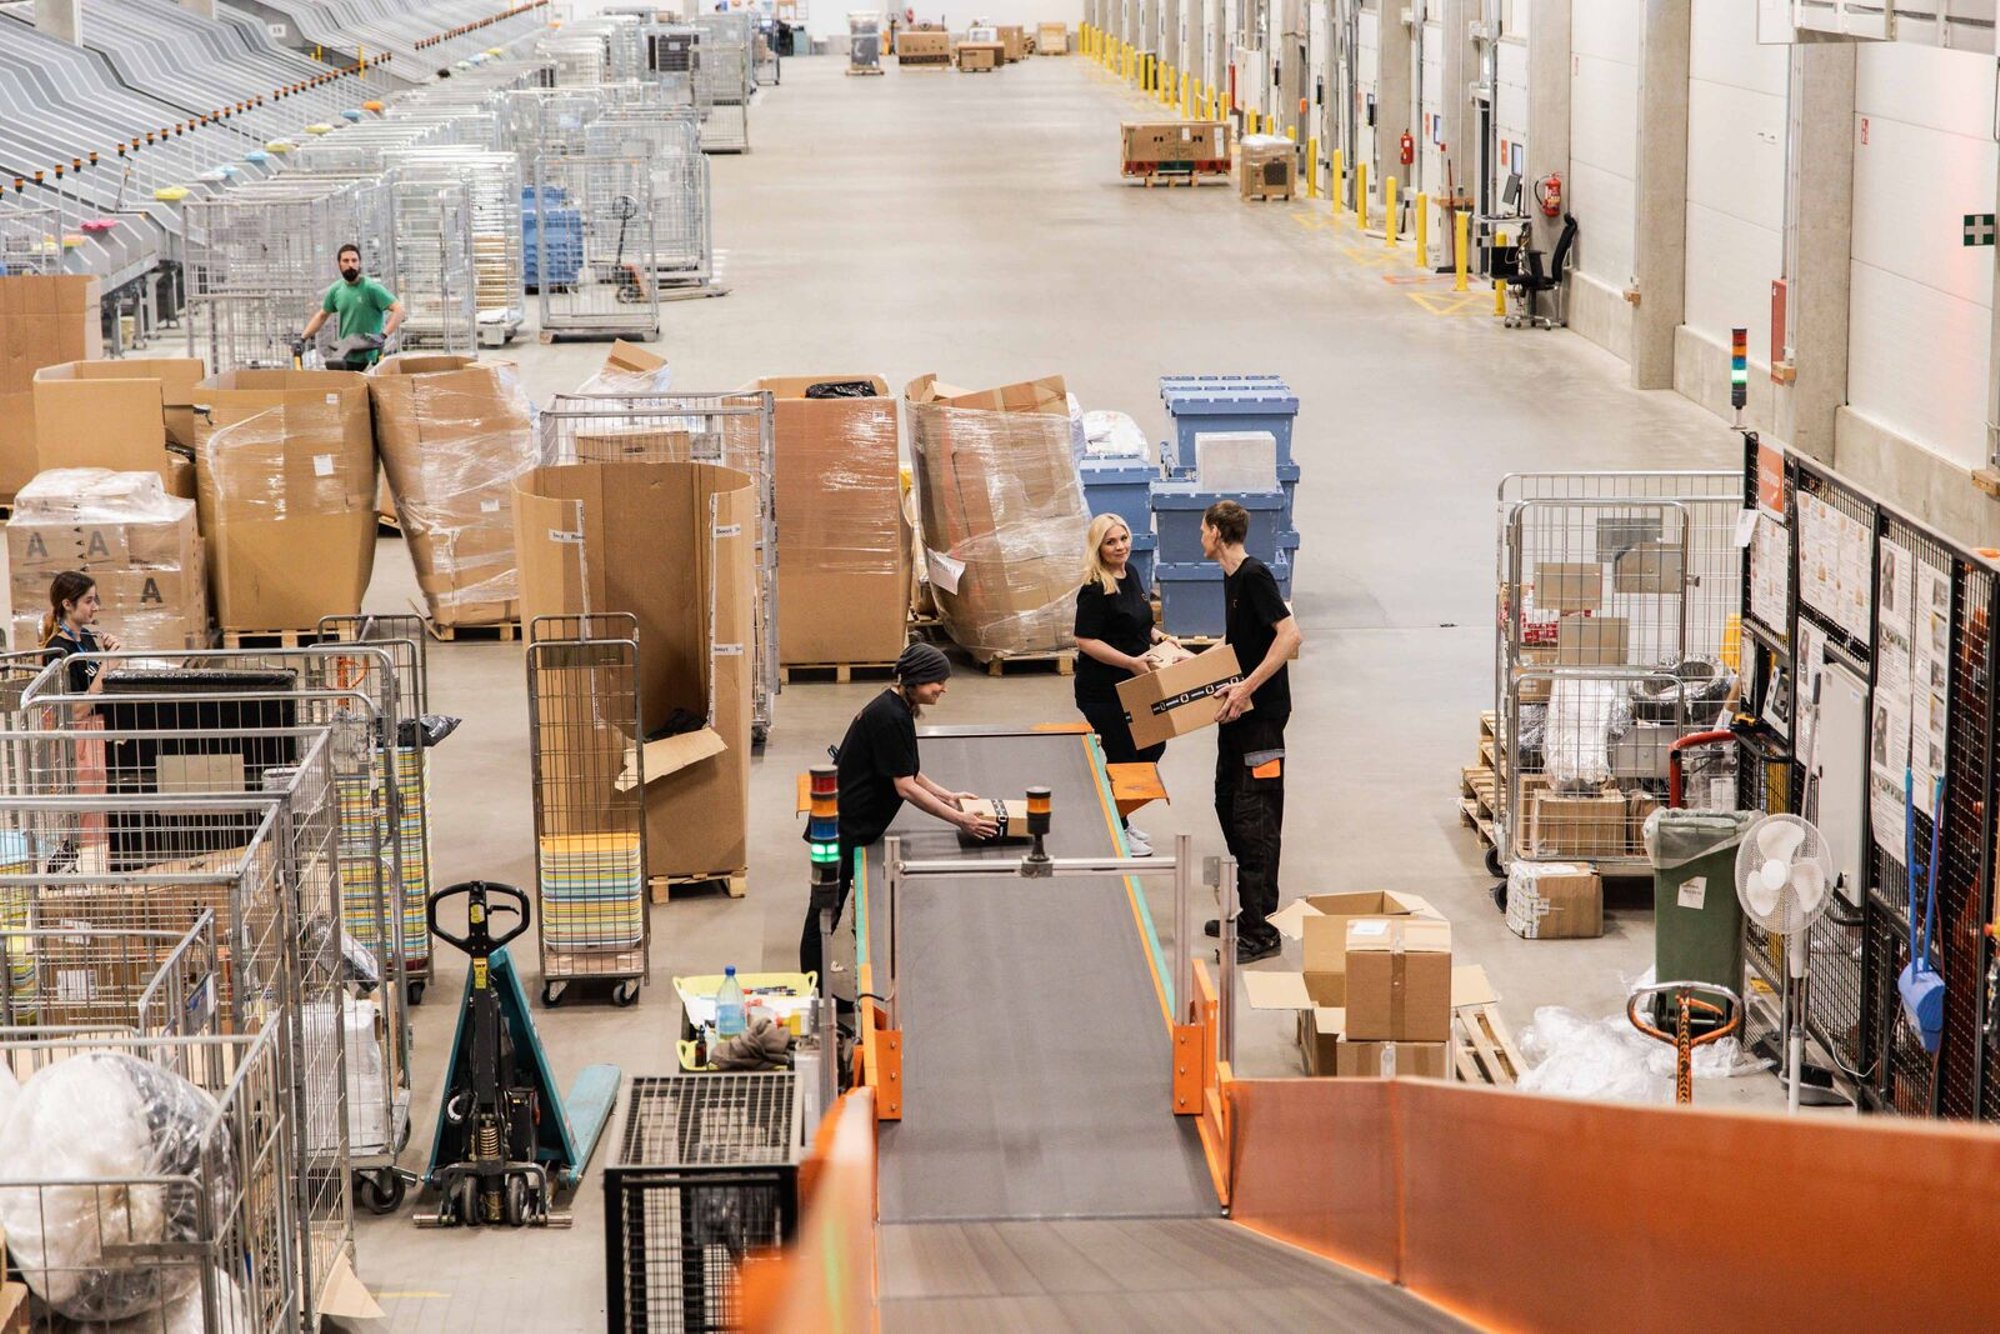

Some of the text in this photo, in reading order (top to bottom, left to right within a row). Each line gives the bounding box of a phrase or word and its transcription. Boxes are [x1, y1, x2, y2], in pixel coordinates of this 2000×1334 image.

[26, 530, 110, 558] A A
[140, 577, 163, 604] A
